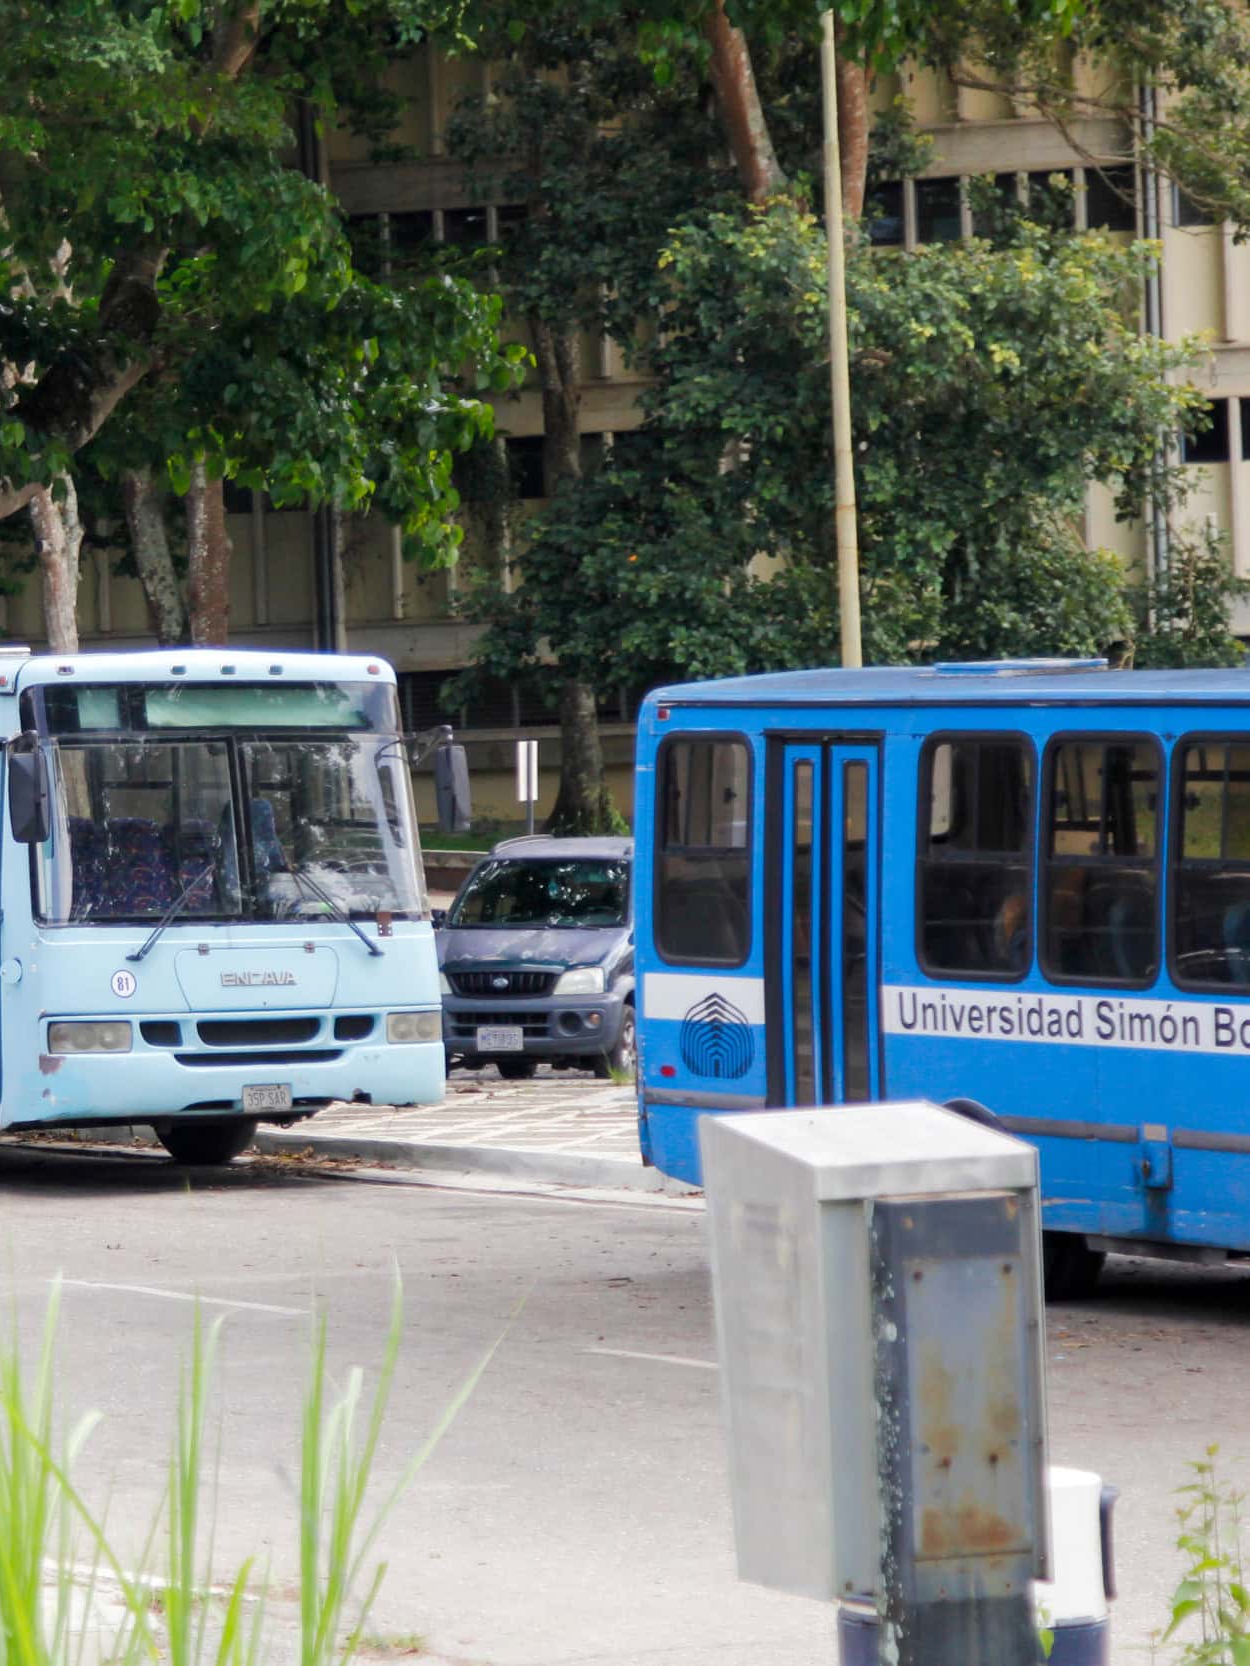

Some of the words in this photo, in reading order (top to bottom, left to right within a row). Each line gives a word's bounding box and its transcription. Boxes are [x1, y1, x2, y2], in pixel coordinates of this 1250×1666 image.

[117, 976, 130, 991] 81
[899, 991, 1084, 1038] Universidad
[1095, 1001, 1200, 1046] Simón
